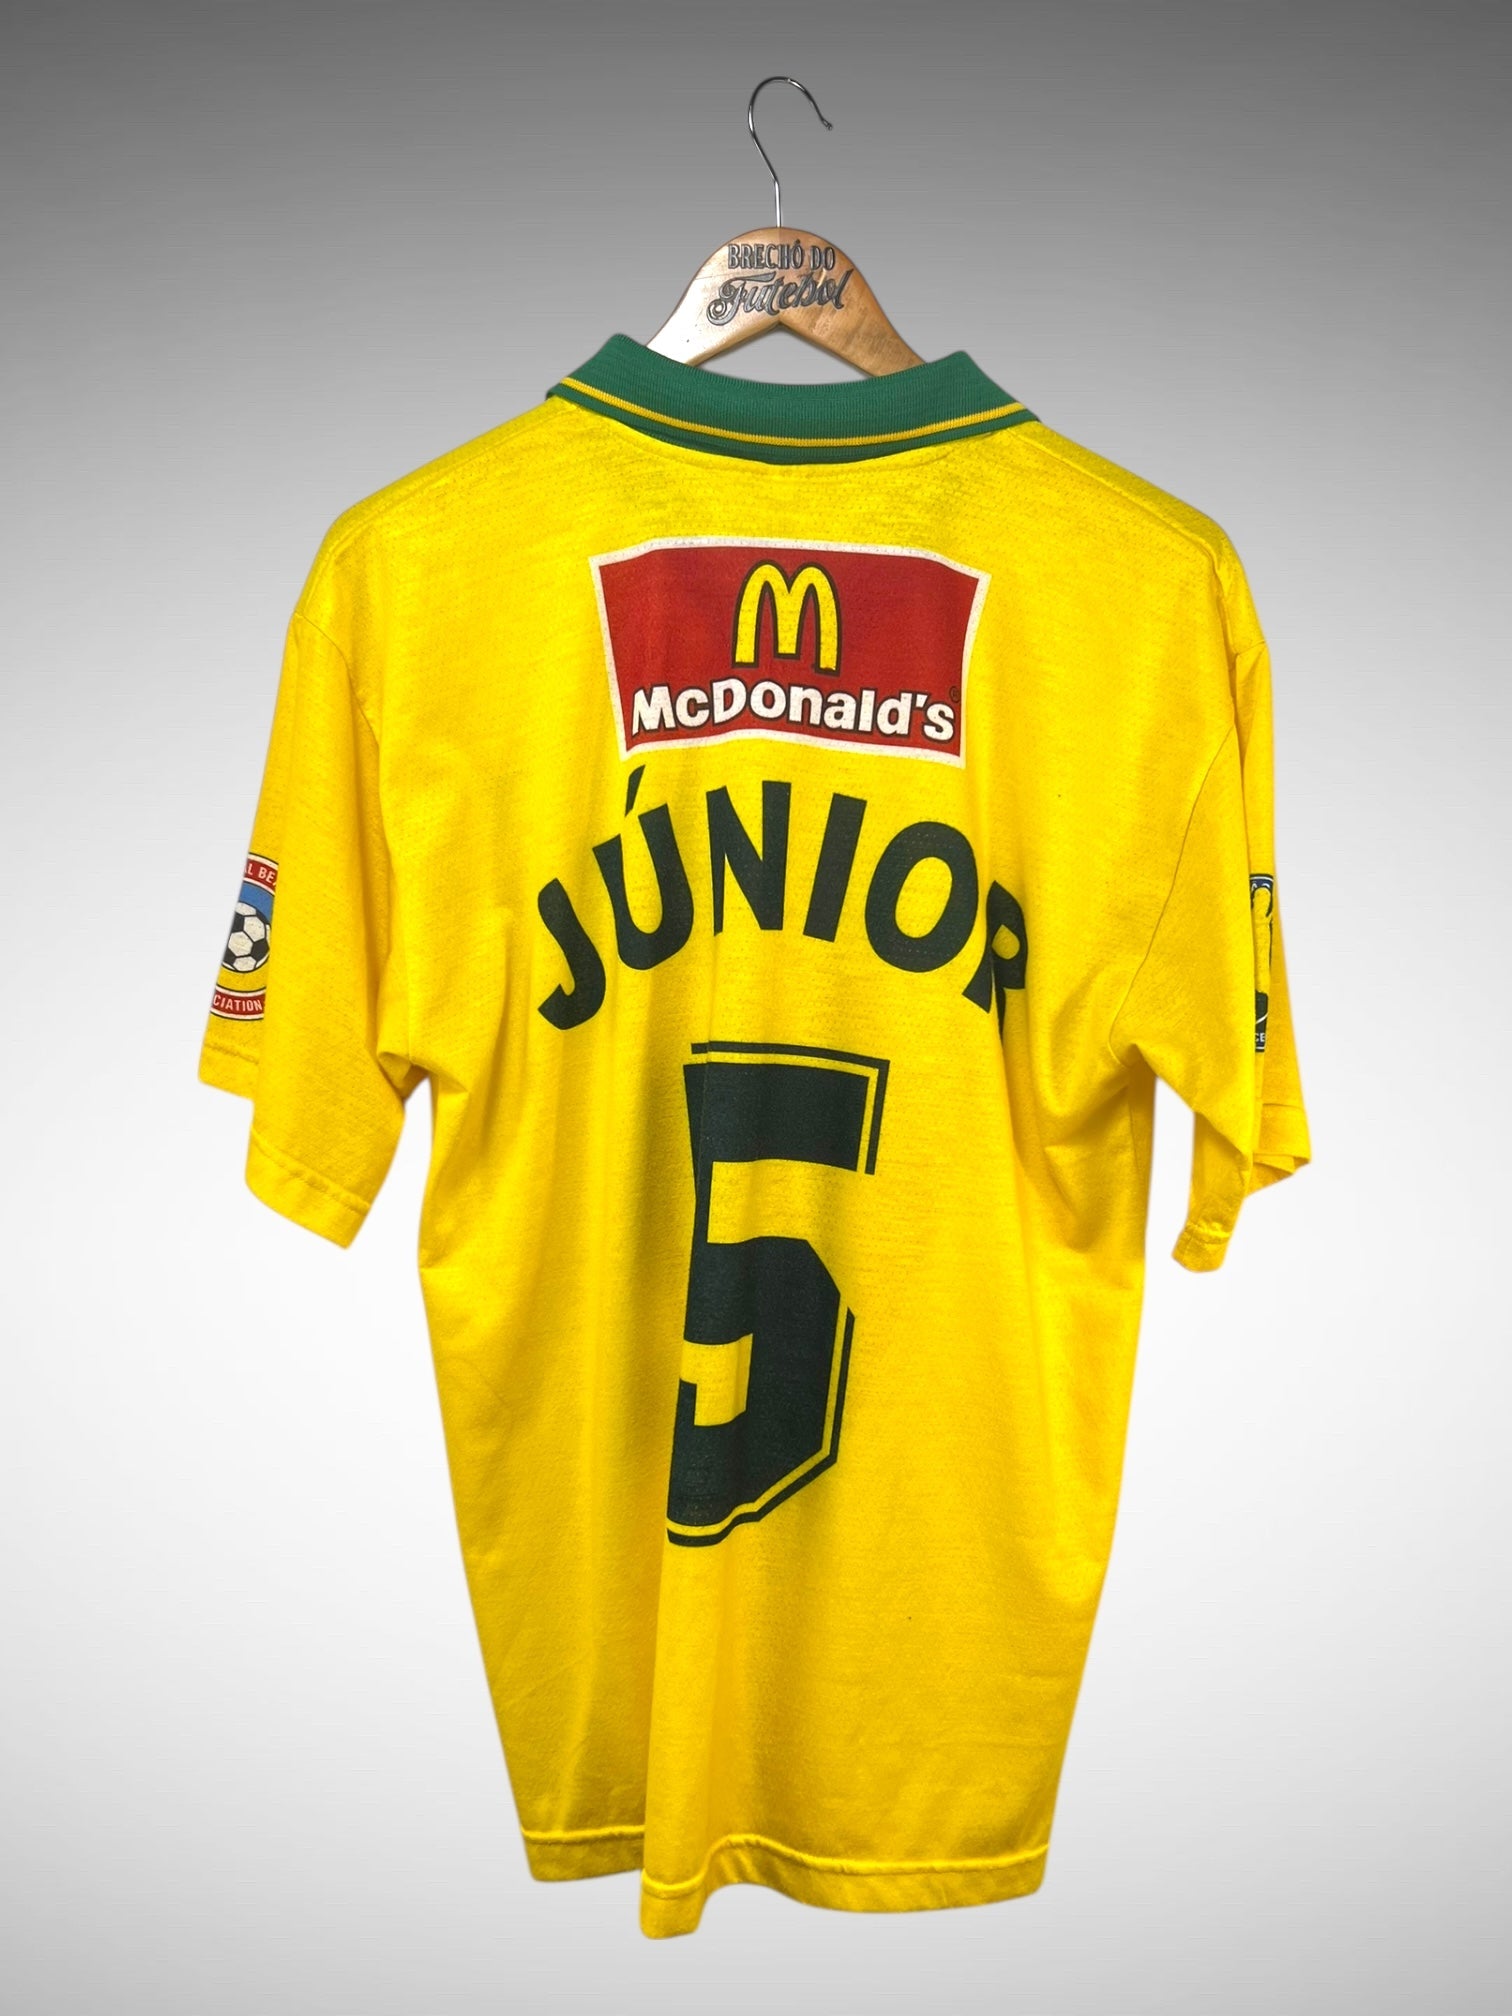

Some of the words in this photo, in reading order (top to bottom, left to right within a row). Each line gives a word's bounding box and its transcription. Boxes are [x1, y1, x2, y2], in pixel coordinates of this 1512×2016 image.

[728, 239, 803, 270] BRECHÓ
[809, 244, 835, 271] DO
[706, 268, 854, 326] Futebol
[630, 676, 956, 742] McDonald's
[258, 866, 277, 886] BE
[537, 766, 1028, 1040] JÚNIOR
[667, 1041, 890, 1547] 5
